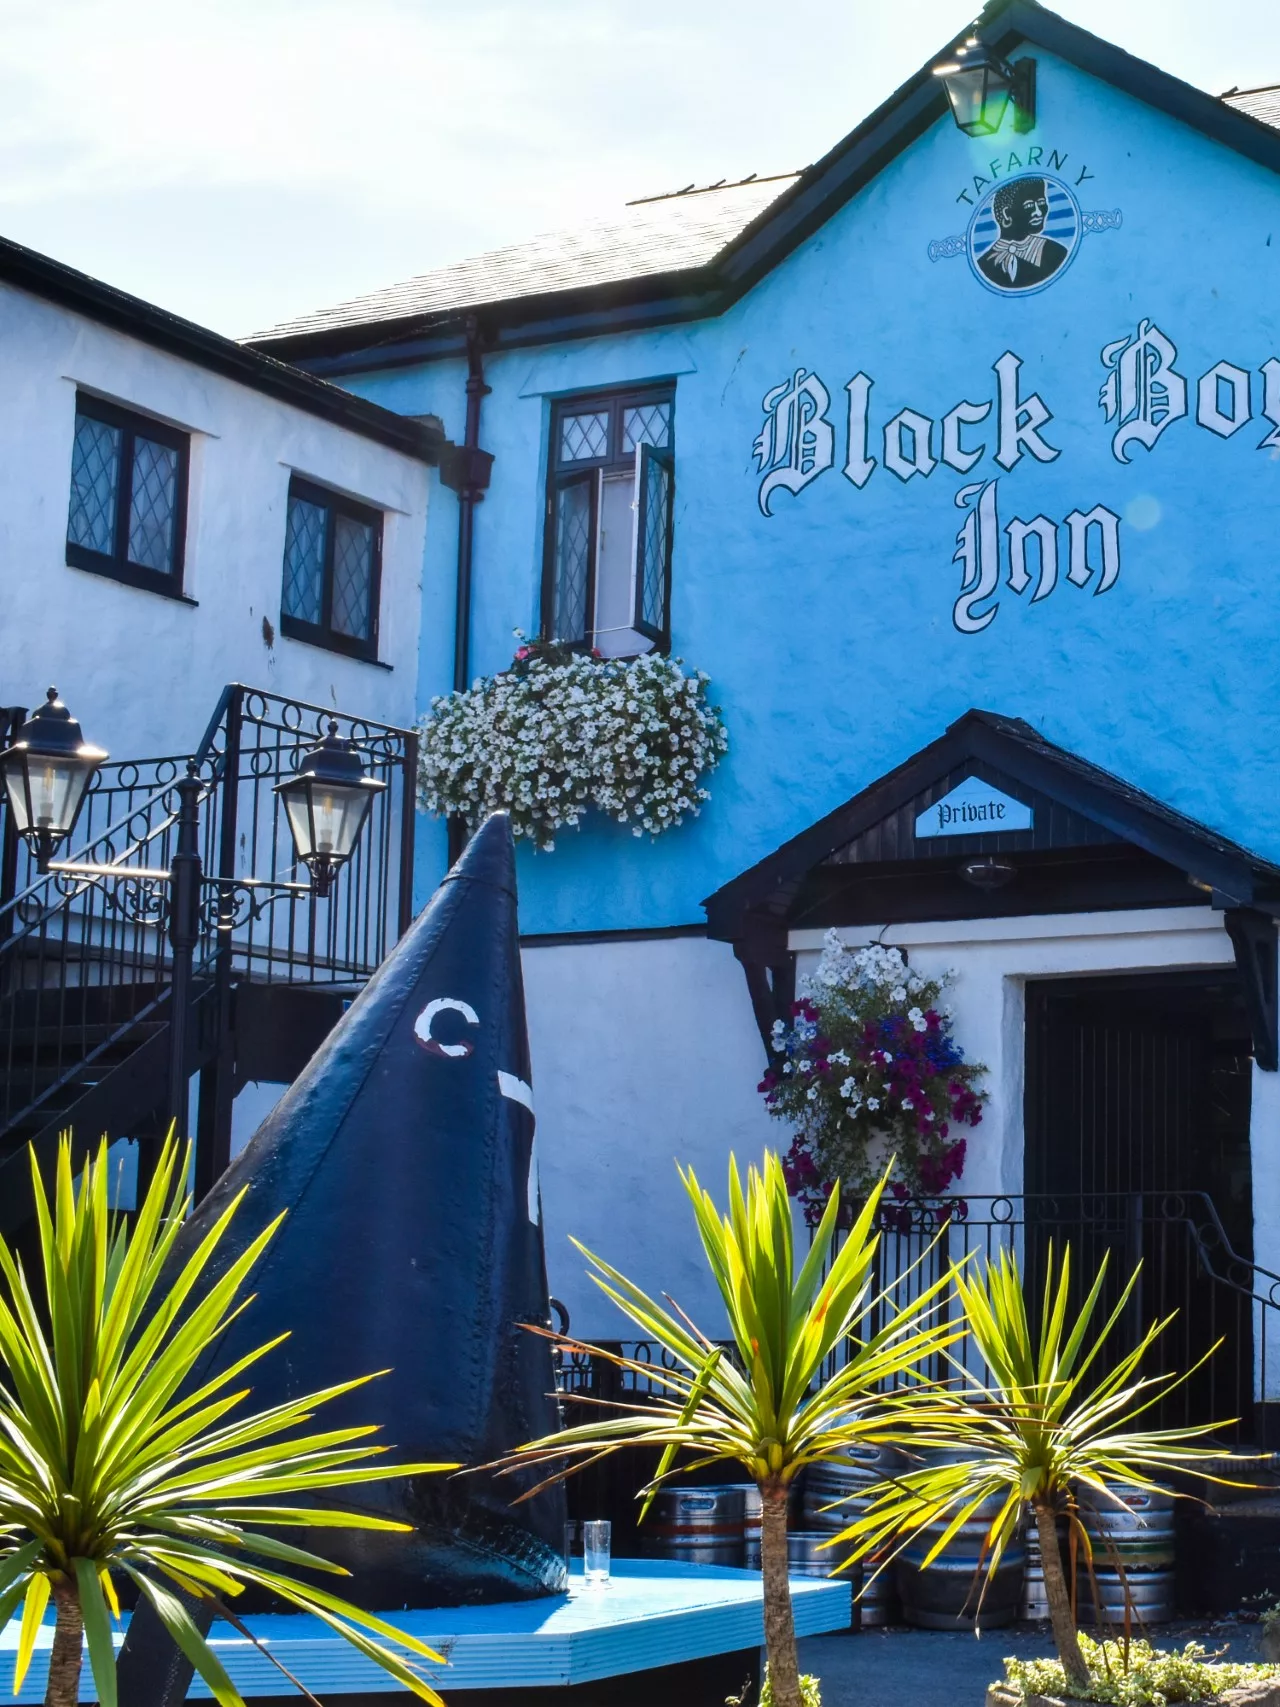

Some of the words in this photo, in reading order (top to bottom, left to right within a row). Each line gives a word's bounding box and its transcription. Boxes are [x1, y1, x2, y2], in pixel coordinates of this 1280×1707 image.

[955, 146, 1069, 206] TAFARN
[1074, 164, 1095, 187] Y
[752, 349, 1062, 518] Black
[952, 477, 1122, 635] Inn
[937, 801, 1006, 829] Private
